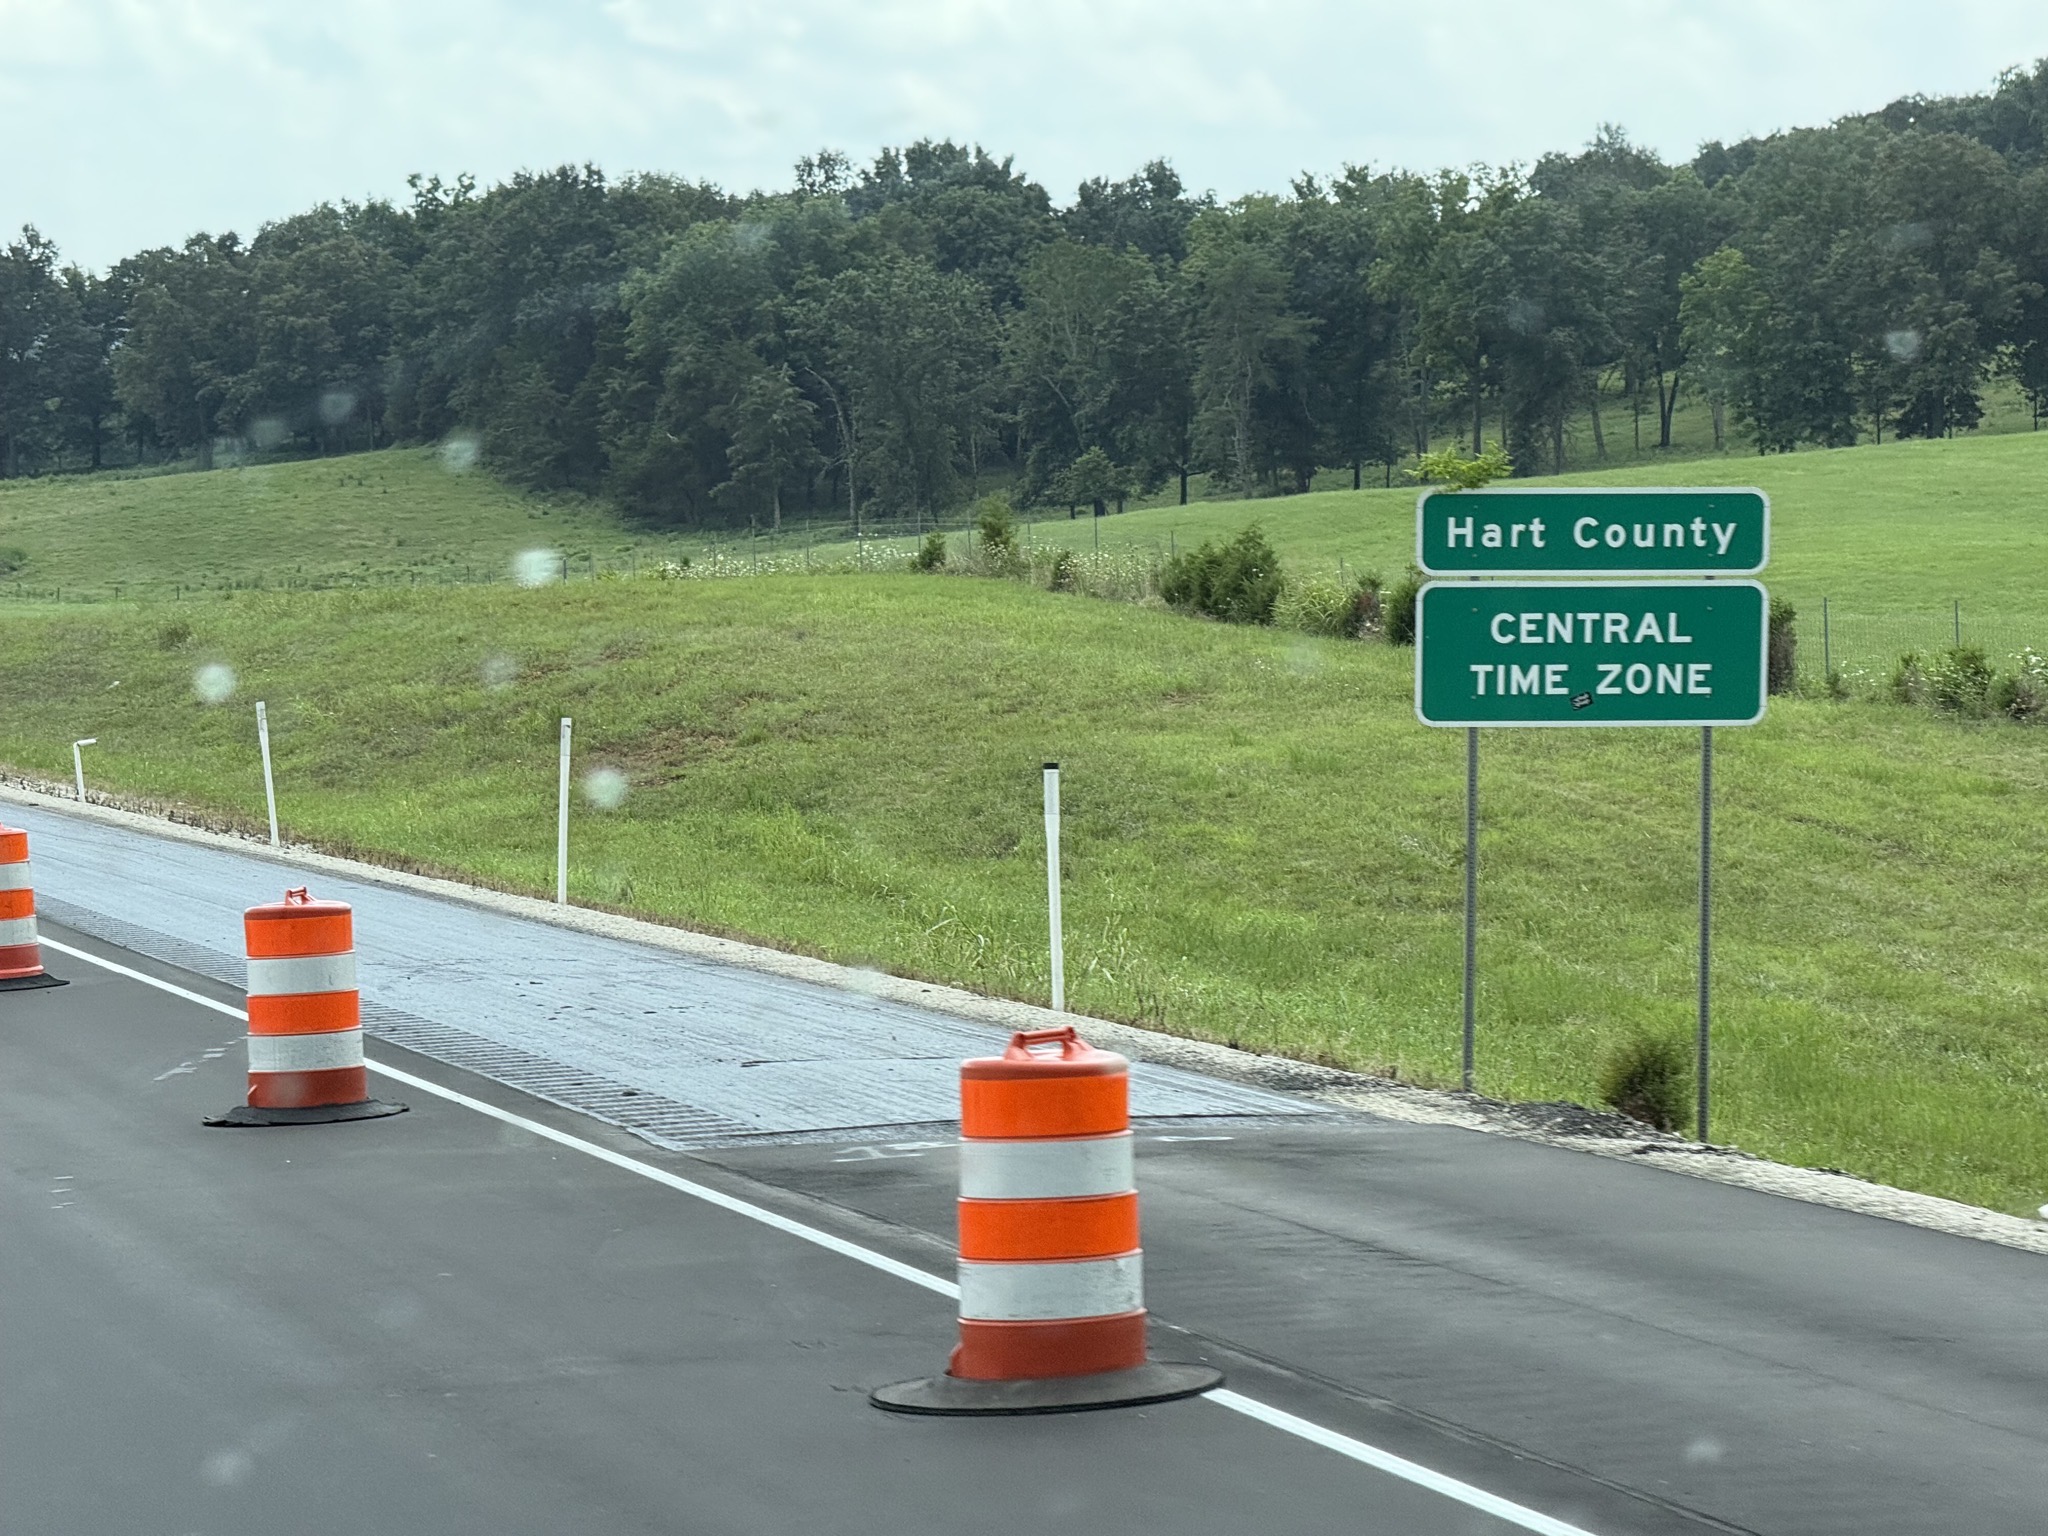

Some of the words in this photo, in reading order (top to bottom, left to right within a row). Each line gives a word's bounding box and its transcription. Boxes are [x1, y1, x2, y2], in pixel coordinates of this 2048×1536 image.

[1447, 516, 1546, 548] Hart
[1573, 516, 1738, 555] County
[1490, 612, 1693, 645] CENTRAL
[1469, 663, 1570, 696] TIME
[1595, 662, 1713, 695] ZONE
